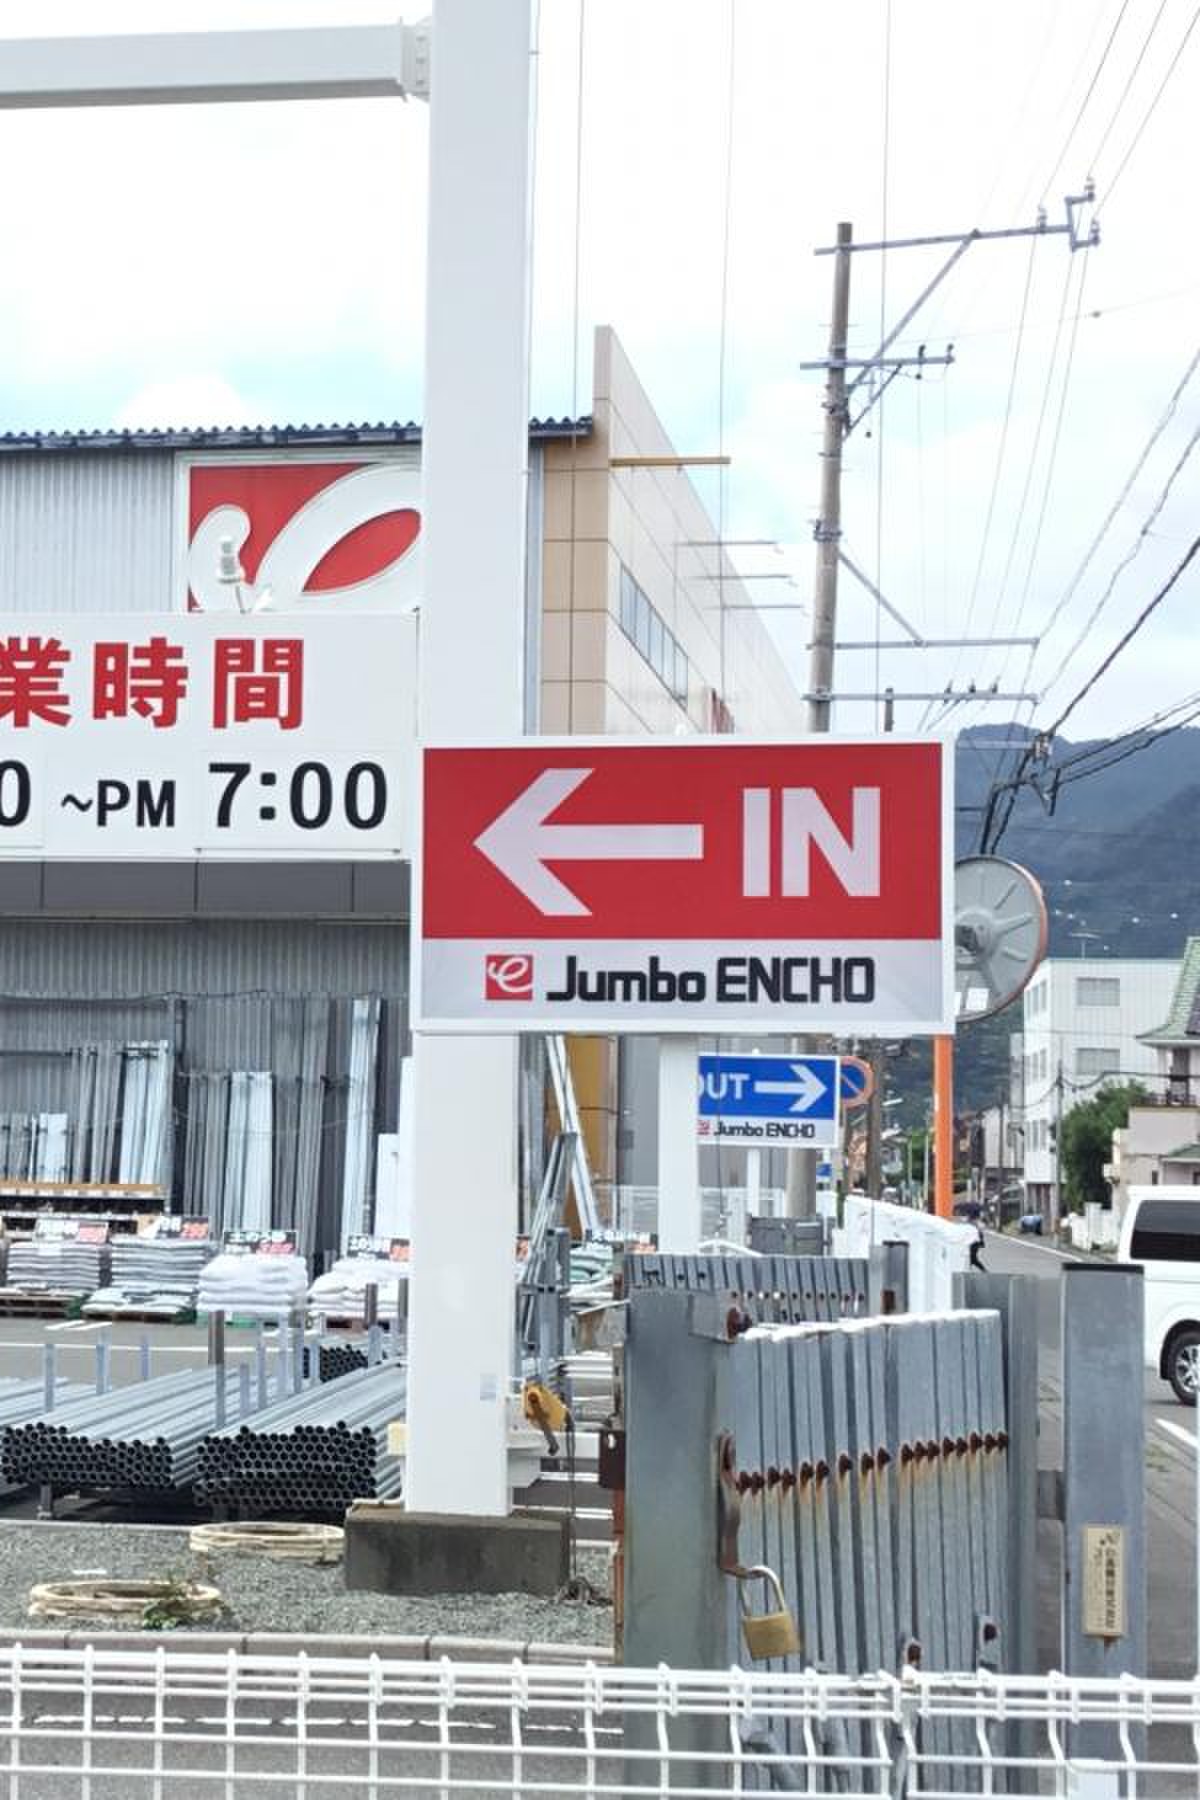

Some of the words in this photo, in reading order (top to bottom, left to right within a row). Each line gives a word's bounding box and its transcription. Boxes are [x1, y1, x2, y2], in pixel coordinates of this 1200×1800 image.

[208, 761, 389, 830] 7:00
[742, 786, 881, 897] IN
[546, 955, 706, 1002] Jumbo
[716, 957, 876, 1004] ENCHO
[714, 1121, 763, 1137] Jumbo
[766, 1122, 815, 1138] ENCHO
